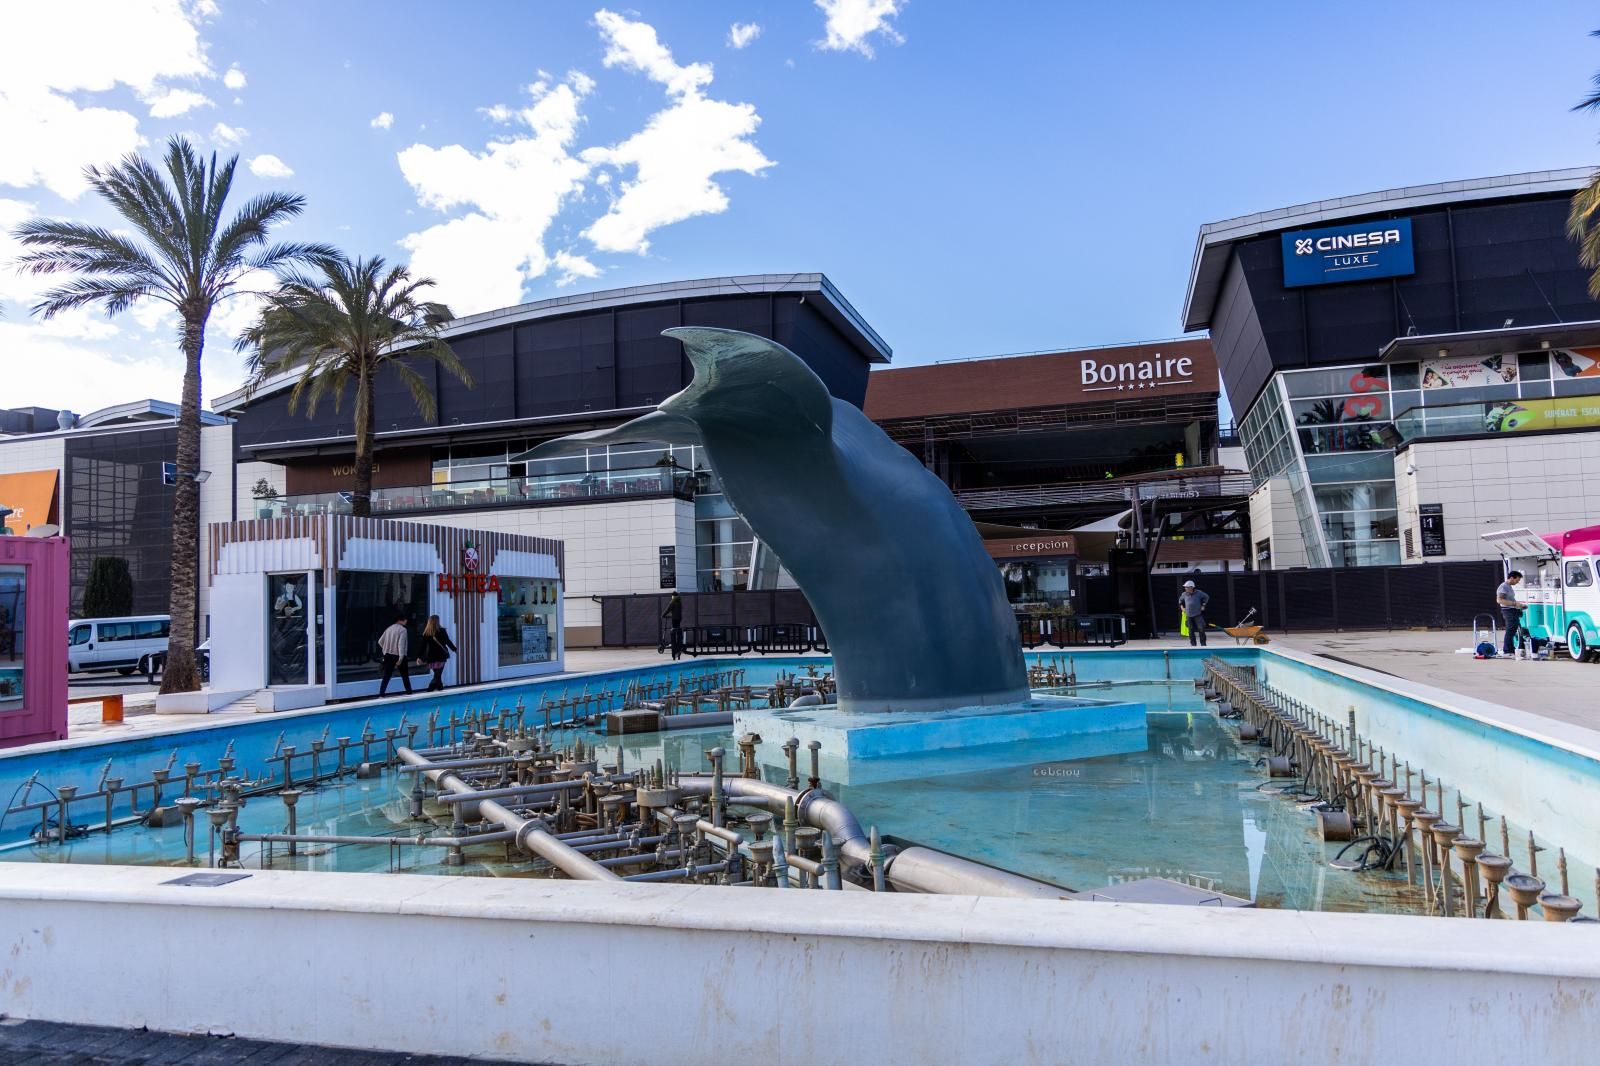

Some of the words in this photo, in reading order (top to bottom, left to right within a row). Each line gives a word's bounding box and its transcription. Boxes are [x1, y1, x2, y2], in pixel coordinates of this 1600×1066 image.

[1316, 229, 1400, 251] CINESA
[1334, 255, 1369, 266] LUXE
[1080, 353, 1193, 385] Bonaire
[463, 573, 501, 593] TEA
